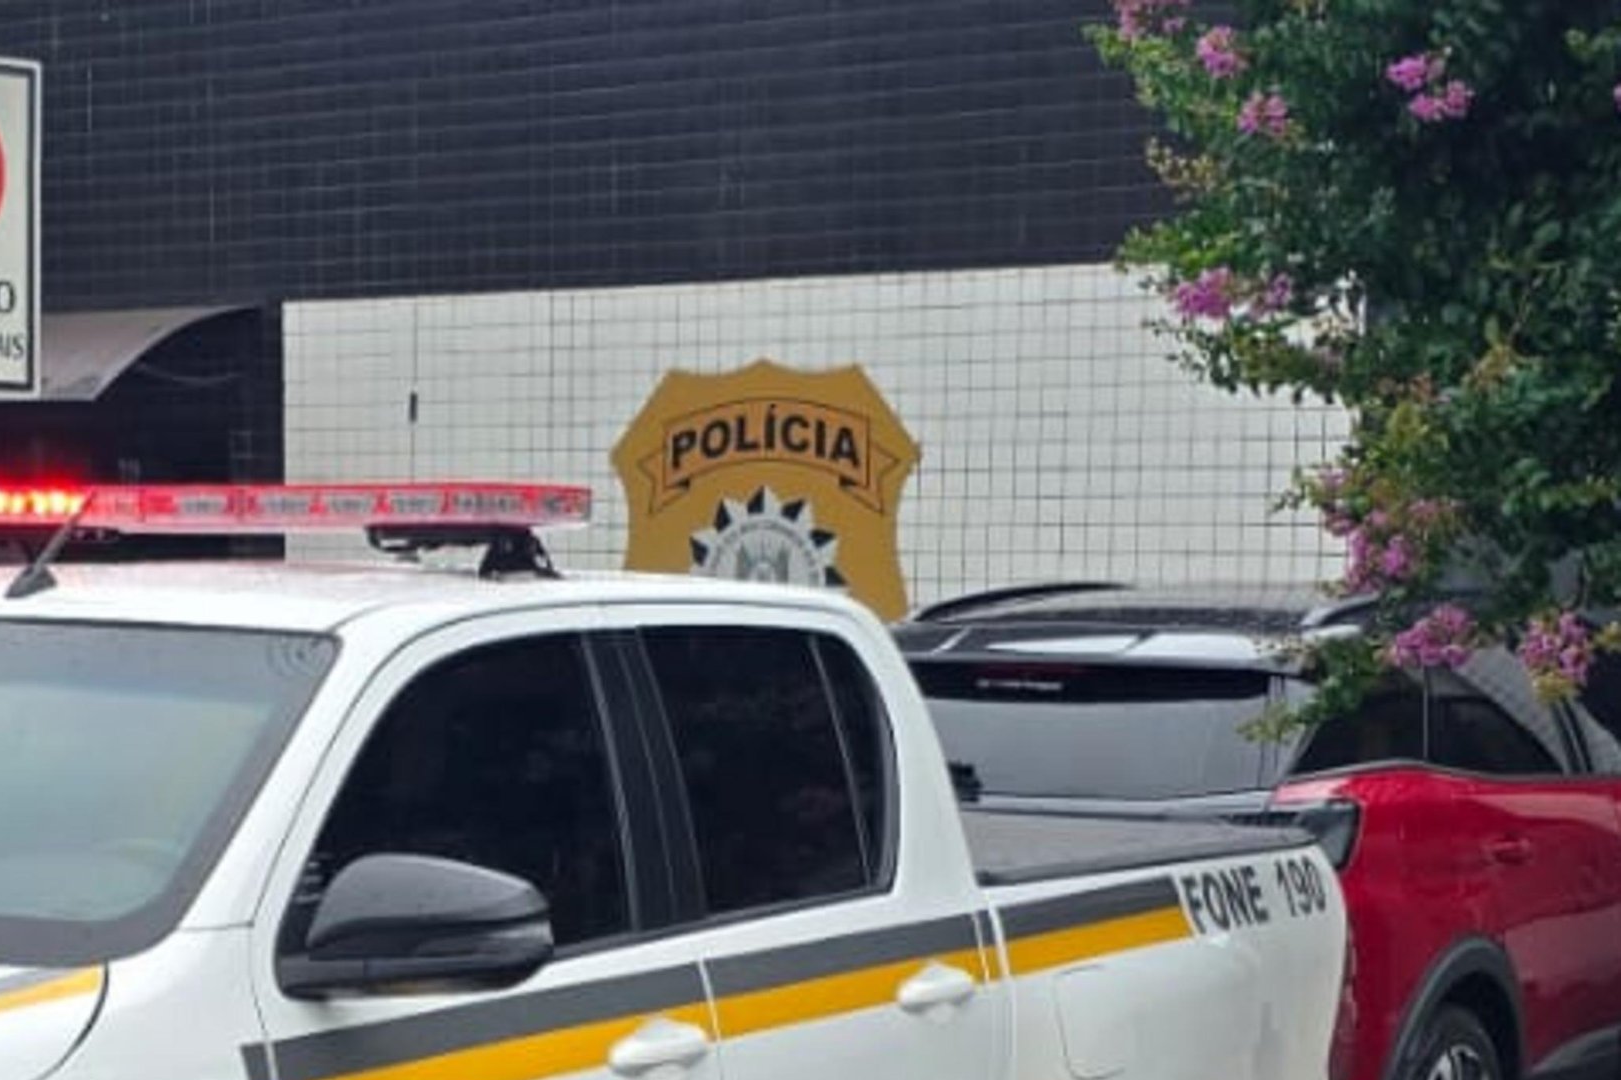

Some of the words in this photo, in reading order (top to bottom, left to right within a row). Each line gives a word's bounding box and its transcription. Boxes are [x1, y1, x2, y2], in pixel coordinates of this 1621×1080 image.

[671, 403, 860, 469] POLÍCIA
[1181, 864, 1269, 934] FONE
[1274, 855, 1326, 917] 190
